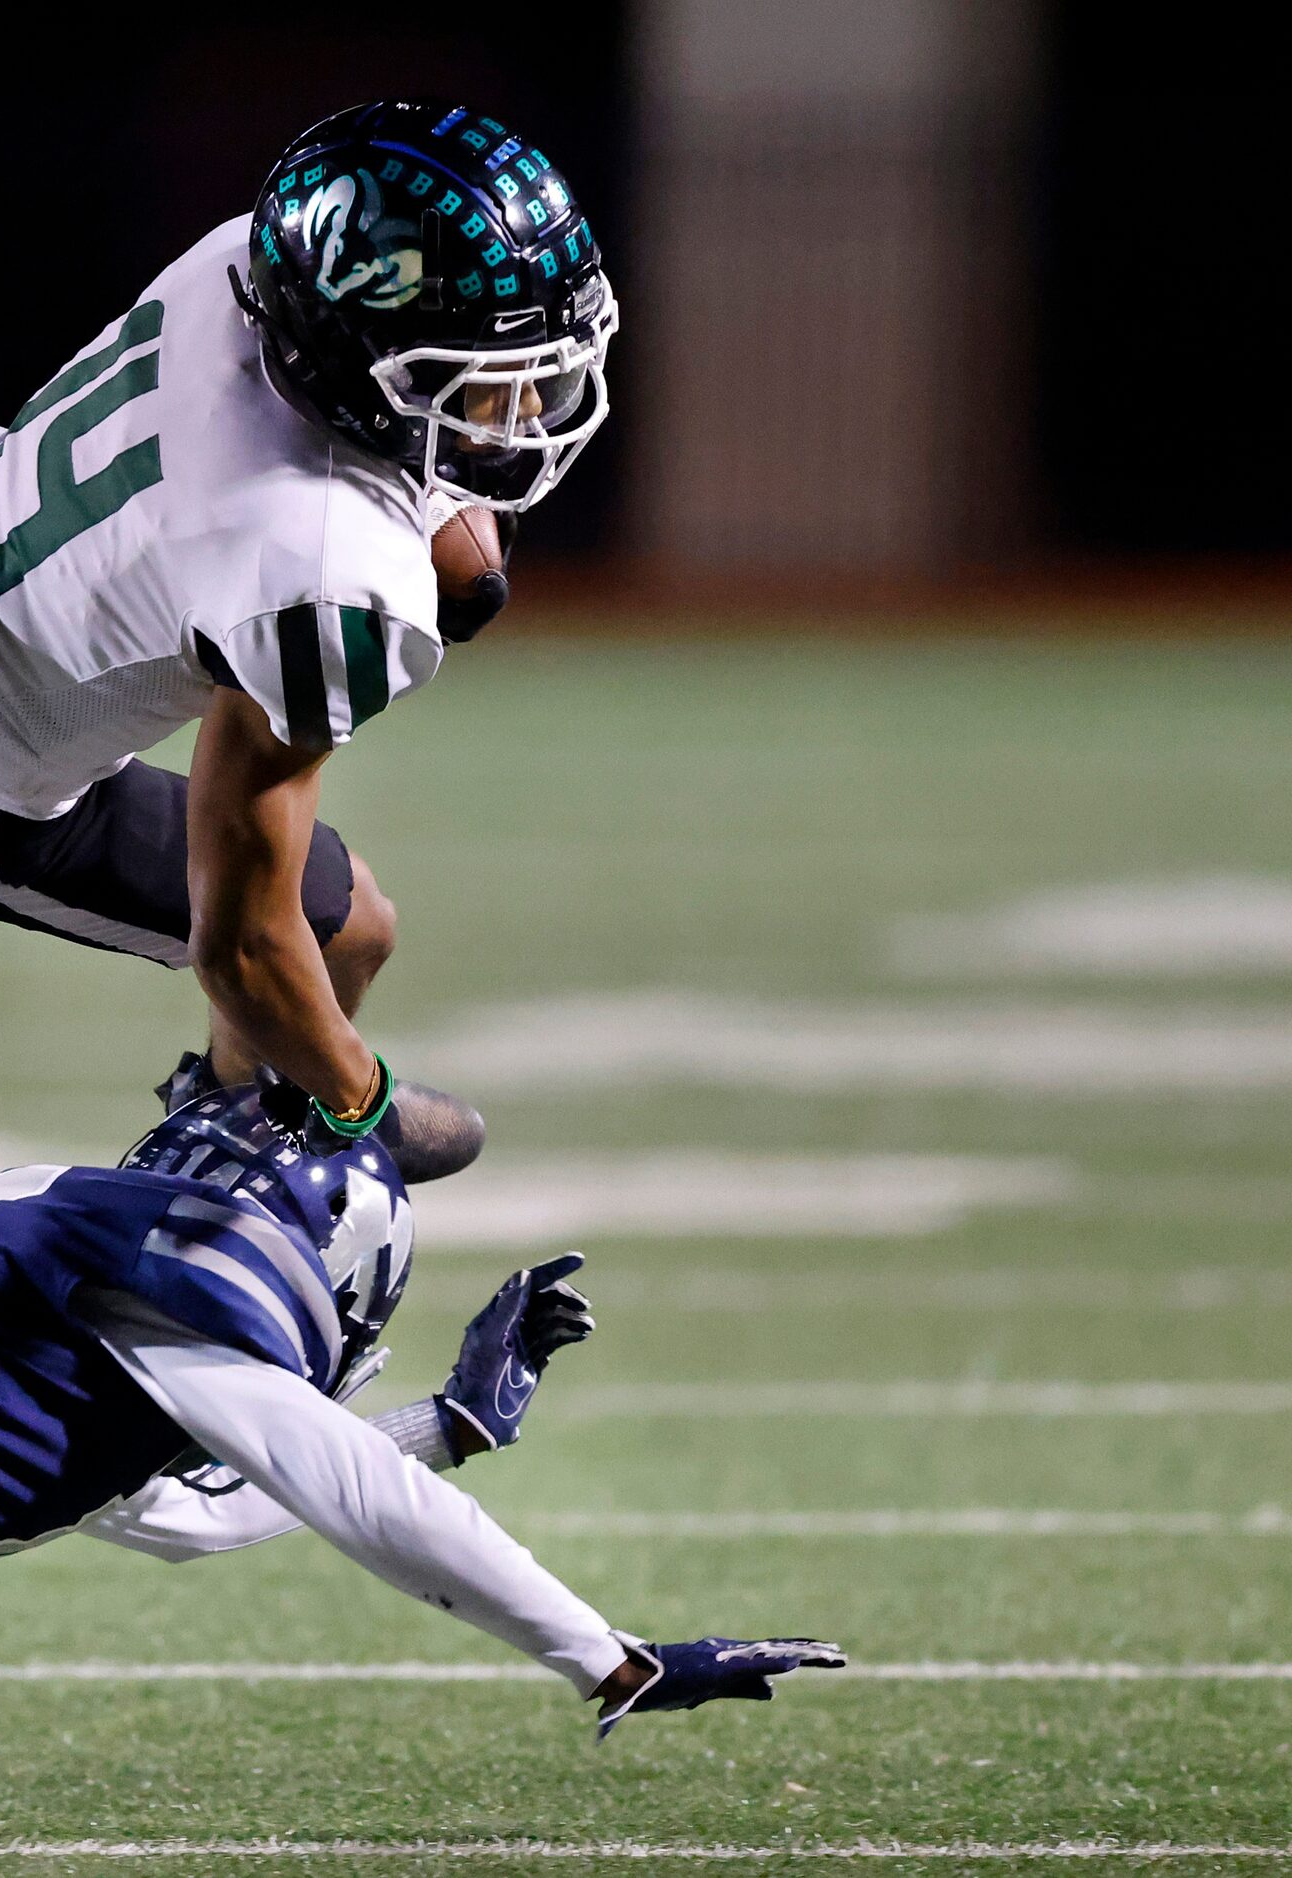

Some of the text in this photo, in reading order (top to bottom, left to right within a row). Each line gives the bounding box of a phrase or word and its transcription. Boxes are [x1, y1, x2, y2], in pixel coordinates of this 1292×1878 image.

[461, 129, 487, 149] B
[379, 159, 403, 181] B
[516, 157, 538, 181] B
[531, 149, 550, 170] B
[279, 170, 296, 193] B
[304, 163, 323, 187] B
[407, 170, 433, 195] B
[494, 173, 519, 200] B
[436, 189, 462, 216] B
[526, 199, 547, 226] B
[460, 212, 486, 239] B
[261, 223, 281, 265] BRT
[482, 239, 507, 267] B
[565, 235, 579, 263] B
[540, 250, 558, 279] B
[456, 271, 482, 296] B
[494, 273, 517, 297] B
